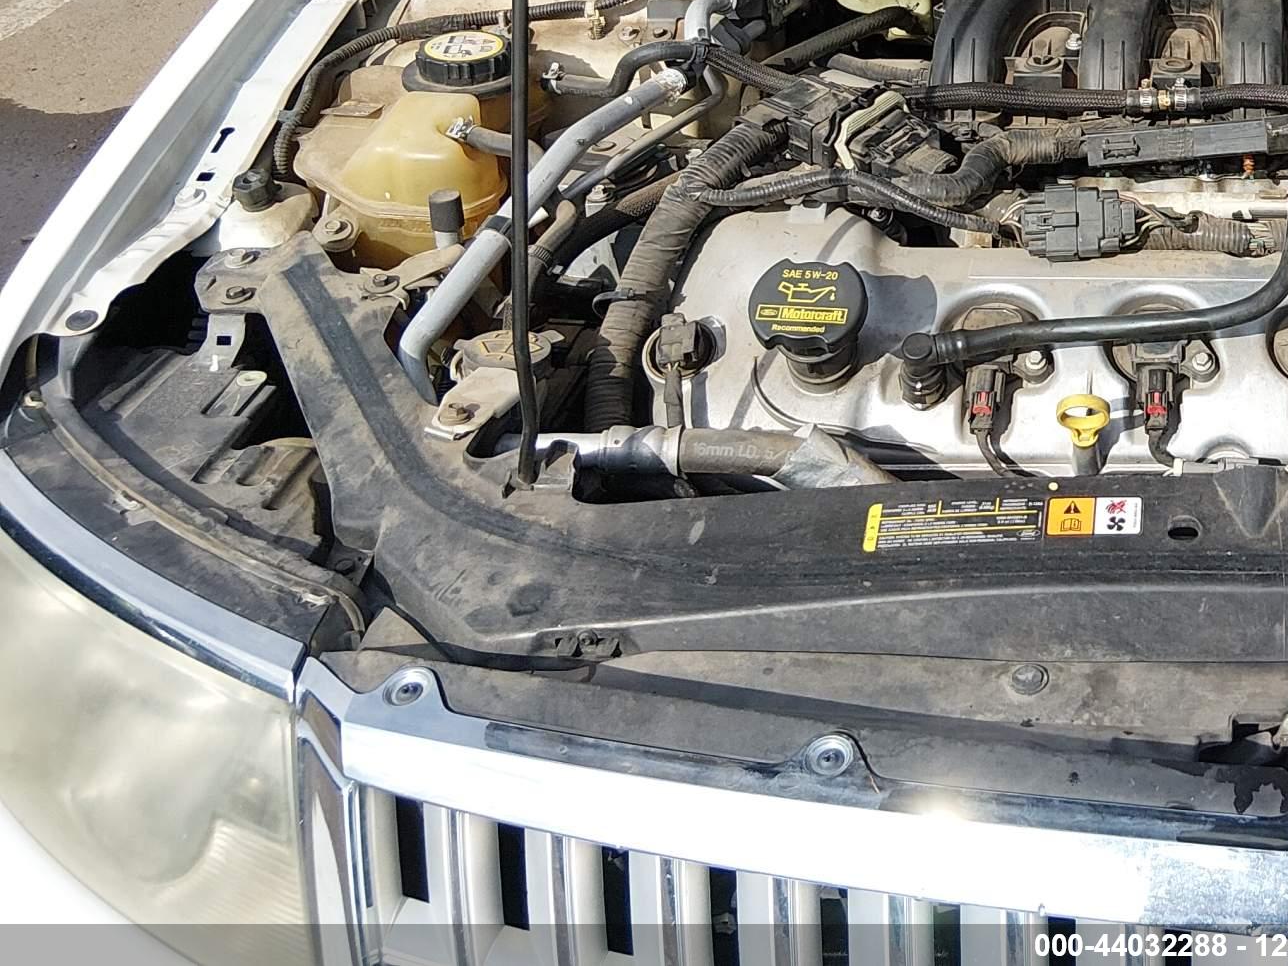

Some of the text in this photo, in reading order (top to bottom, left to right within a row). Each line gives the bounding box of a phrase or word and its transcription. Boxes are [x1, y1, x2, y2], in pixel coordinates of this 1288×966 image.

[782, 268, 839, 281] SAE 5W-20
[781, 307, 845, 322] Motorcraft
[771, 323, 826, 334] Recommended
[693, 441, 734, 457] 16mm
